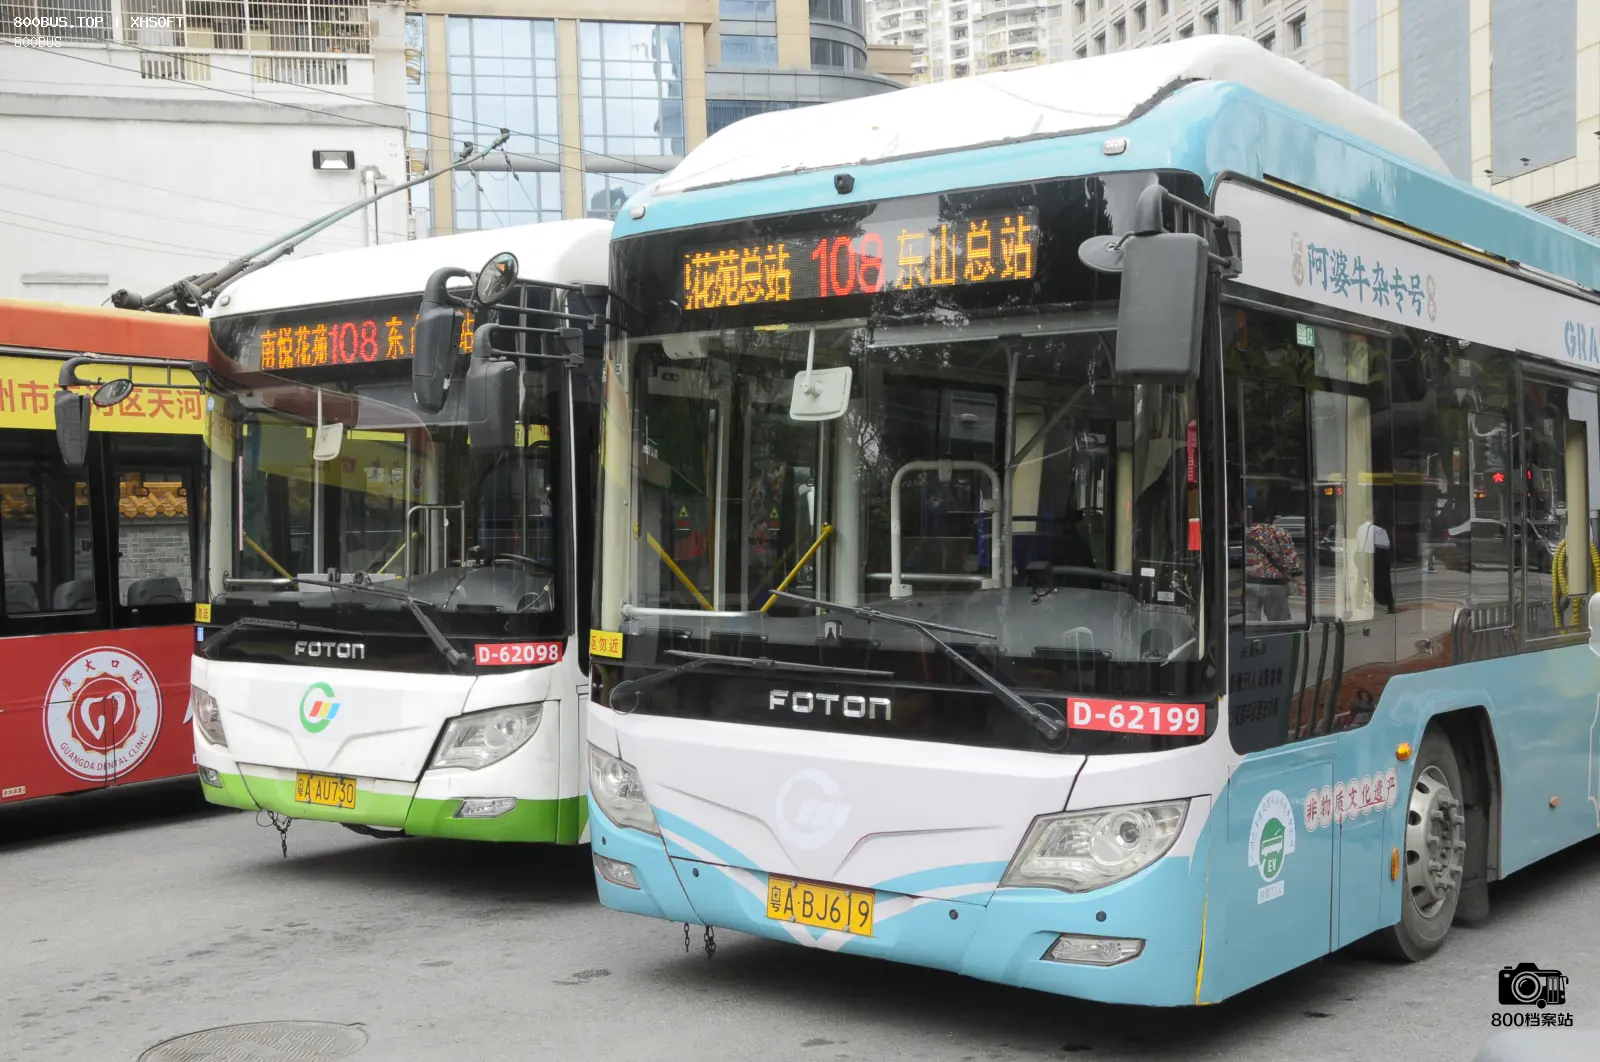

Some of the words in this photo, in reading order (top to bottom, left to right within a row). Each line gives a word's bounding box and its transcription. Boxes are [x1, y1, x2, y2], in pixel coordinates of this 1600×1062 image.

[811, 232, 885, 298] 108
[896, 214, 1033, 290] 东山总站
[1307, 242, 1425, 318] 阿婆牛杂专号
[329, 320, 379, 365] 108
[295, 640, 366, 660] FOTON
[478, 643, 560, 663] D-62098
[769, 689, 891, 721] FOTON
[1073, 701, 1200, 732] D-62199
[60, 742, 95, 771] GUANGDA
[97, 756, 128, 772] DENTAL
[128, 731, 149, 758] CLINIC
[1307, 776, 1396, 822] 非物质文化遗产
[1267, 857, 1277, 873] EV
